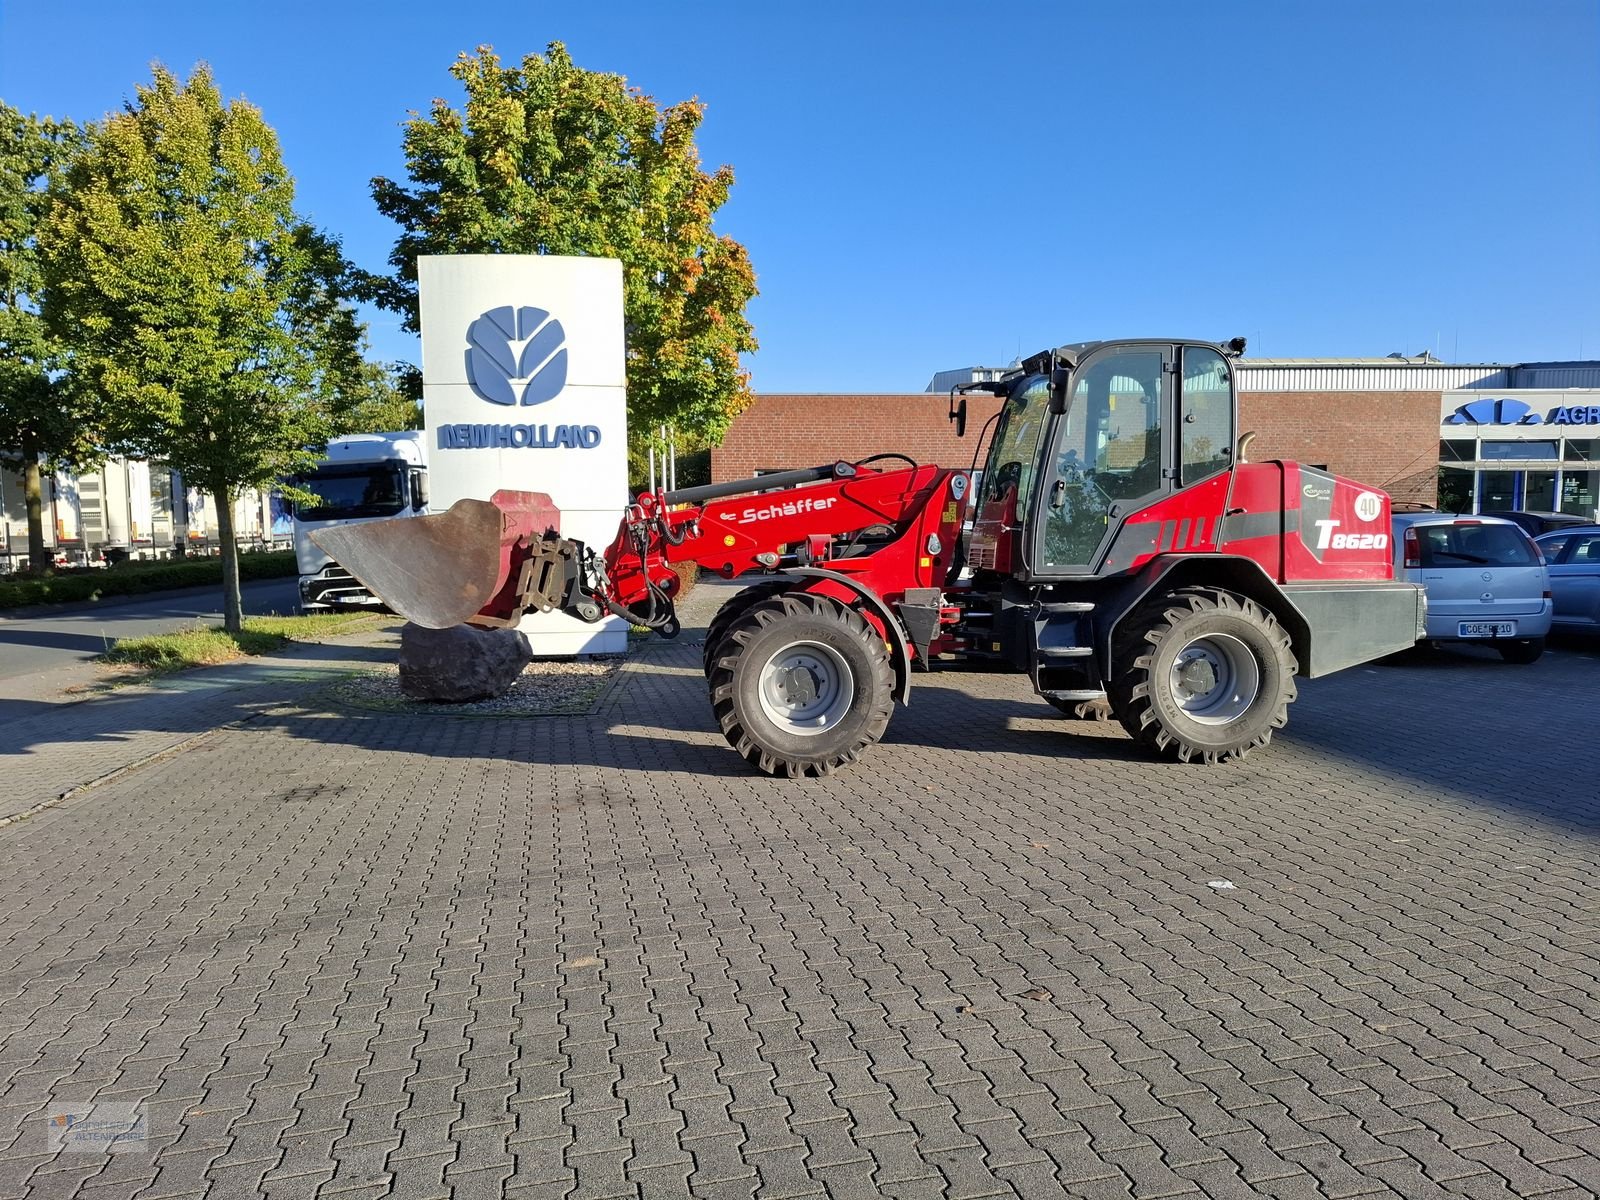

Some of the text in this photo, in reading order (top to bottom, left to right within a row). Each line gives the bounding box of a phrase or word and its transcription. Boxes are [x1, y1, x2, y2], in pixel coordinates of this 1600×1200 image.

[437, 424, 601, 449] NEW HOLLAND
[738, 497, 837, 524] Schäffer
[1360, 497, 1376, 516] 40
[1466, 624, 1484, 634] COE
[1501, 624, 1512, 633] 10
